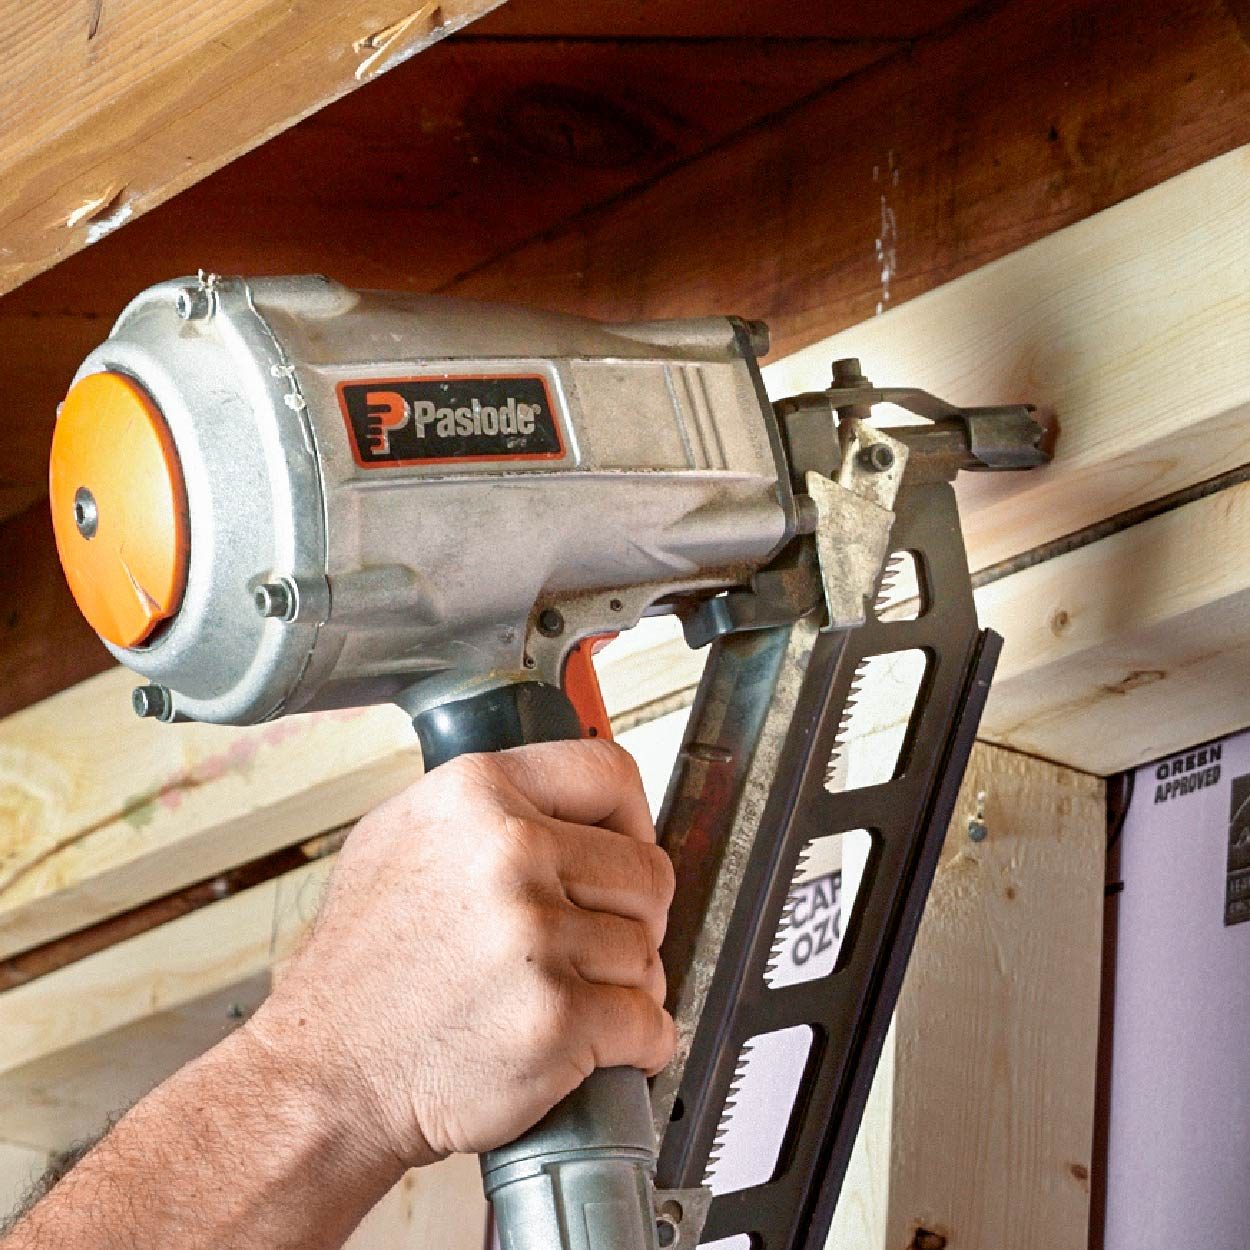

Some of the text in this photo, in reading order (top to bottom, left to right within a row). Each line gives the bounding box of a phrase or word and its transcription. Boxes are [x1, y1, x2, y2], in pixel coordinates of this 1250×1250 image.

[414, 398, 536, 438] Paslode
[1156, 743, 1222, 780] GREEN
[1154, 764, 1221, 803] APPROVED
